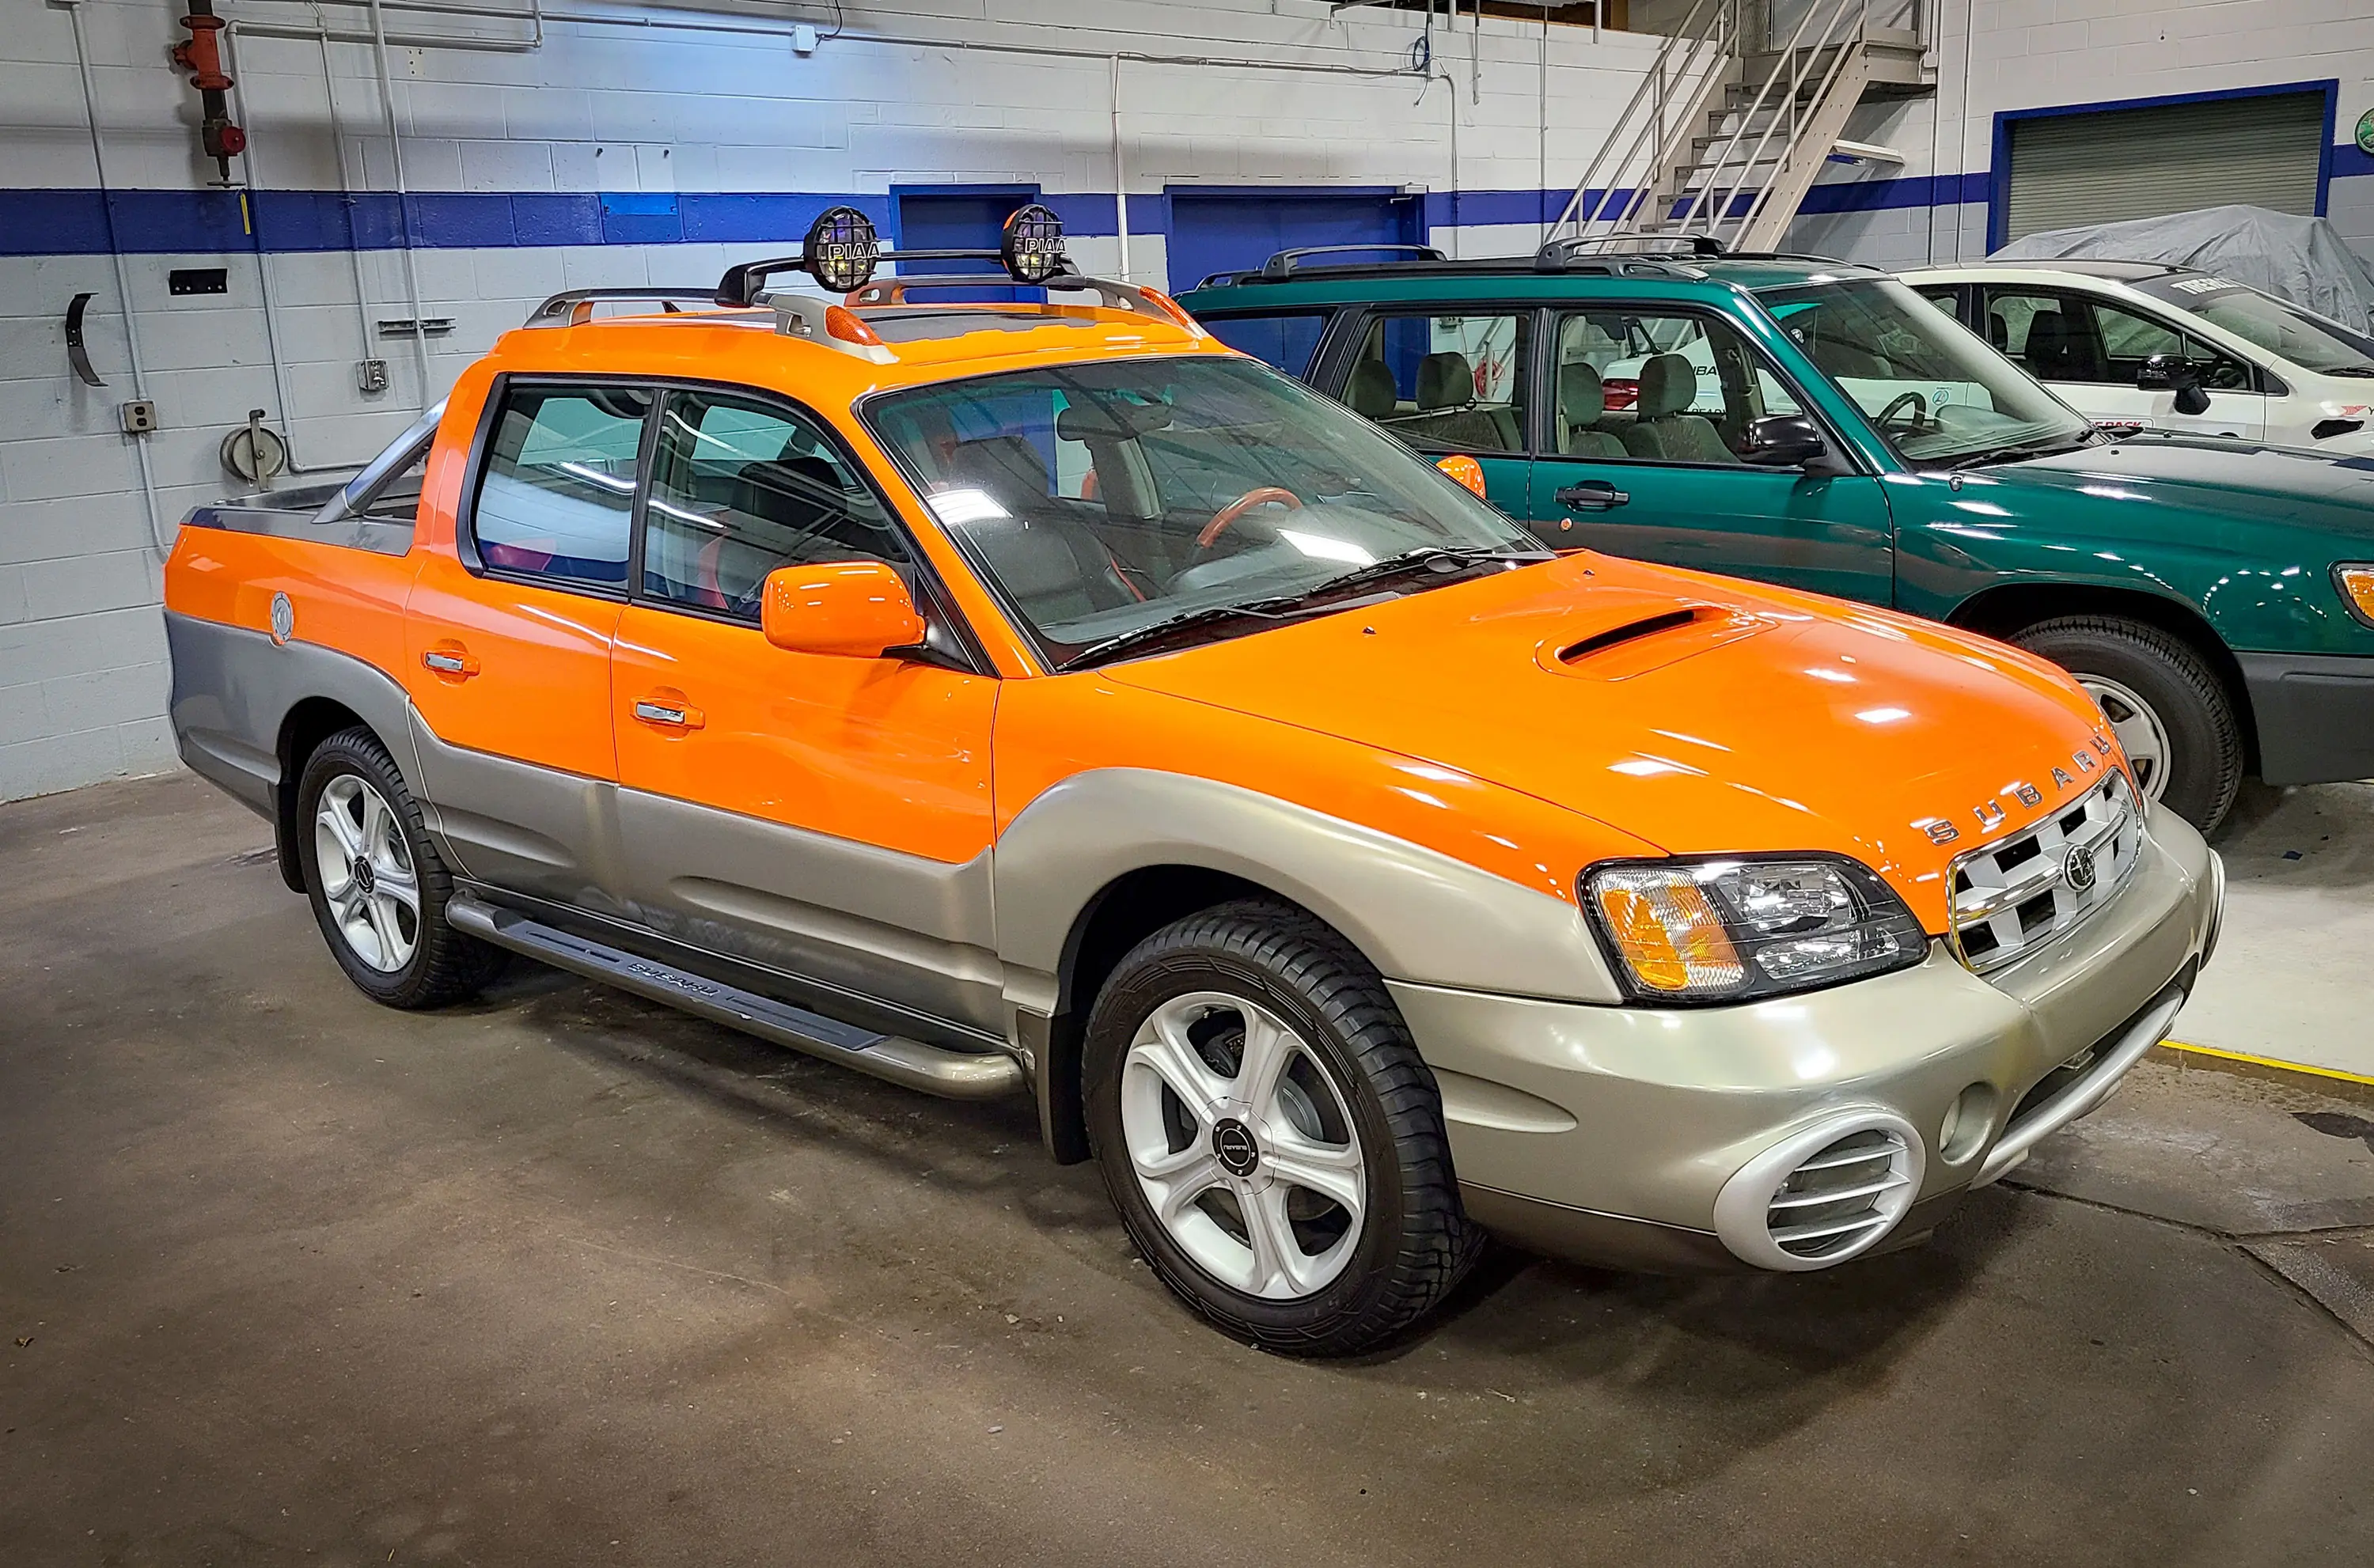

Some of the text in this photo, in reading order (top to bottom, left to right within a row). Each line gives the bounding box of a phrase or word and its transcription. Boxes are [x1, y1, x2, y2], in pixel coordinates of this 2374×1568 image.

[828, 241, 882, 261] PIAA
[1025, 237, 1068, 254] PIAA
[1924, 734, 2111, 846] SUBARU
[628, 963, 721, 997] SUBARU
